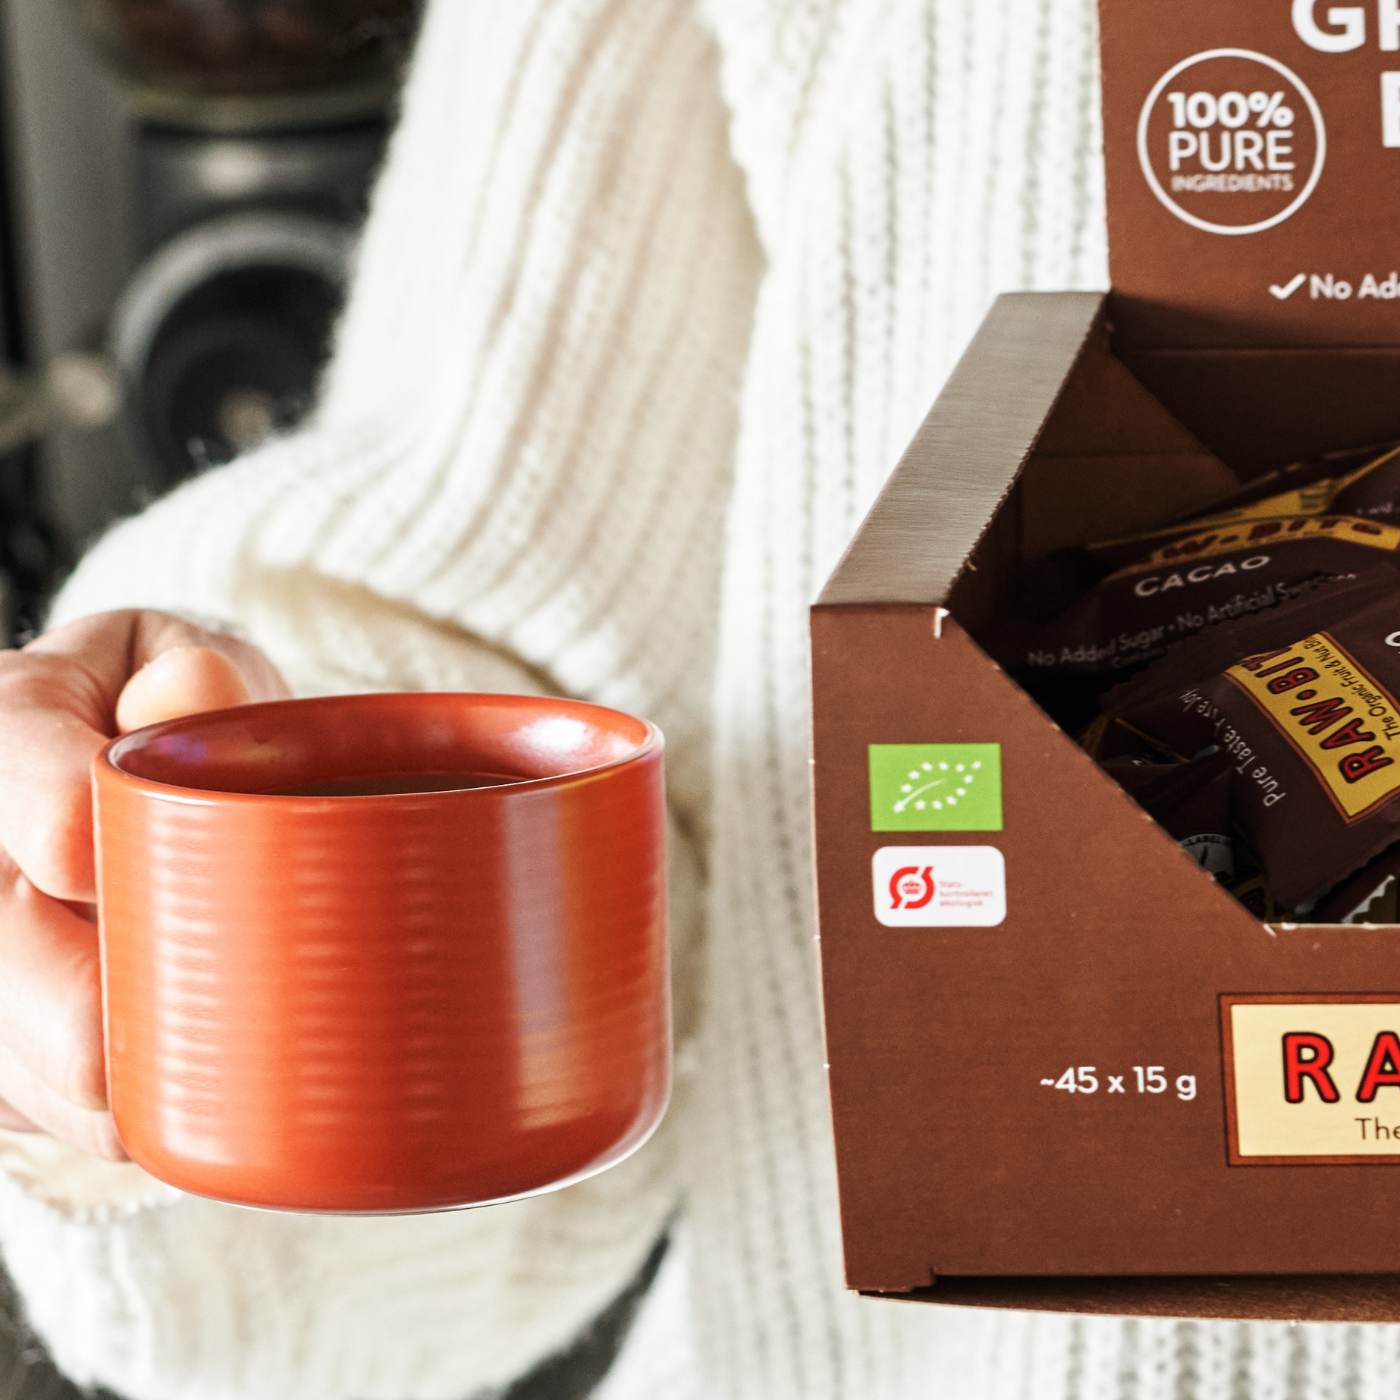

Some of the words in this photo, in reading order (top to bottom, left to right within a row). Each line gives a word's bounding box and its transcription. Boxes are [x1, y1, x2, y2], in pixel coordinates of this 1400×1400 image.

[1167, 91, 1295, 129] 100%
[1169, 130, 1295, 172] PURE
[1171, 173, 1294, 193] INGREDIENTS
[1310, 272, 1352, 300] No
[1133, 554, 1272, 598] CACAO
[1027, 648, 1057, 668] No
[1059, 638, 1115, 666] Added
[1117, 622, 1168, 653] Sugar
[1175, 611, 1206, 633] No
[1207, 585, 1278, 626] Artificial
[1351, 684, 1387, 718] Organic
[1222, 724, 1257, 776] Taste.
[1251, 765, 1288, 808] Pure
[1040, 1066, 1098, 1094] ~45
[1107, 1074, 1126, 1094] x
[1132, 1066, 1168, 1094] 15
[1176, 1073, 1197, 1100] g
